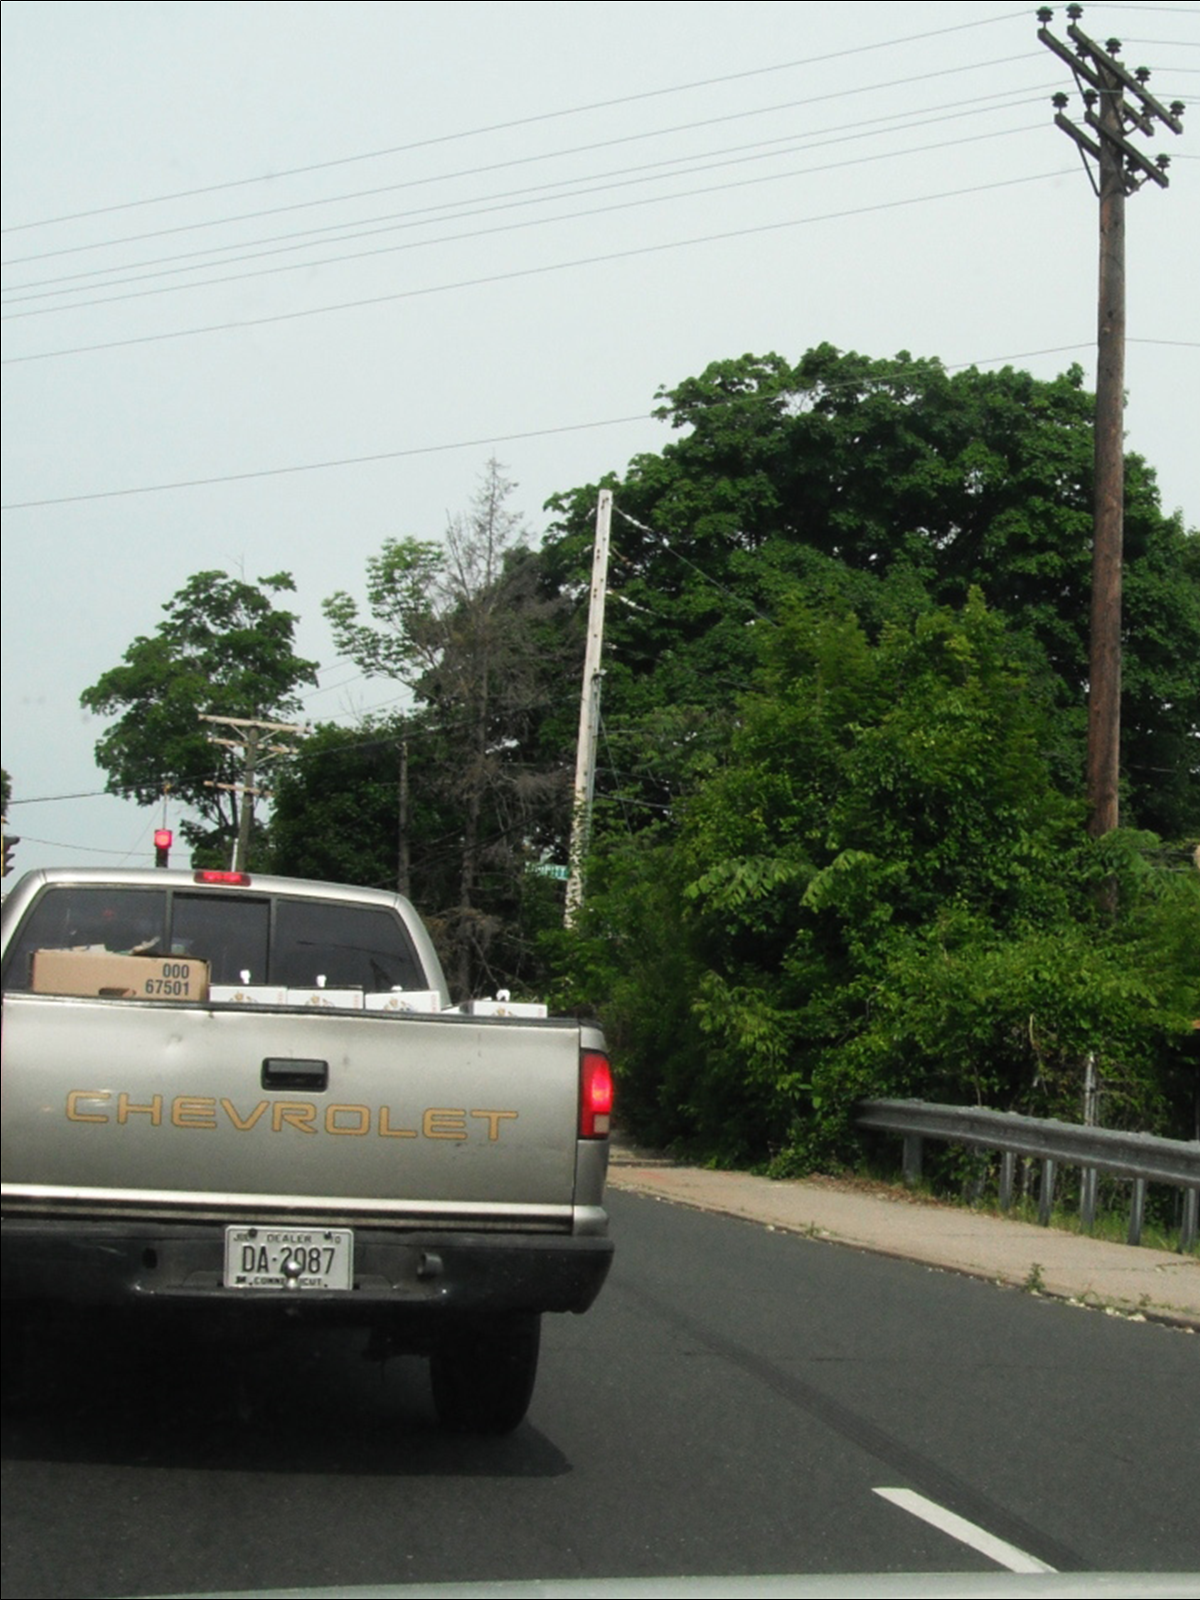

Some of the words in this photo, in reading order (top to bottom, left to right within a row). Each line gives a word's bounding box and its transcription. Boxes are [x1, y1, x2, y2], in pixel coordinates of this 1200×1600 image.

[162, 962, 190, 979] 000
[145, 979, 190, 996] 67501
[65, 1089, 519, 1142] CHEVROLET
[267, 1234, 312, 1244] DEALER
